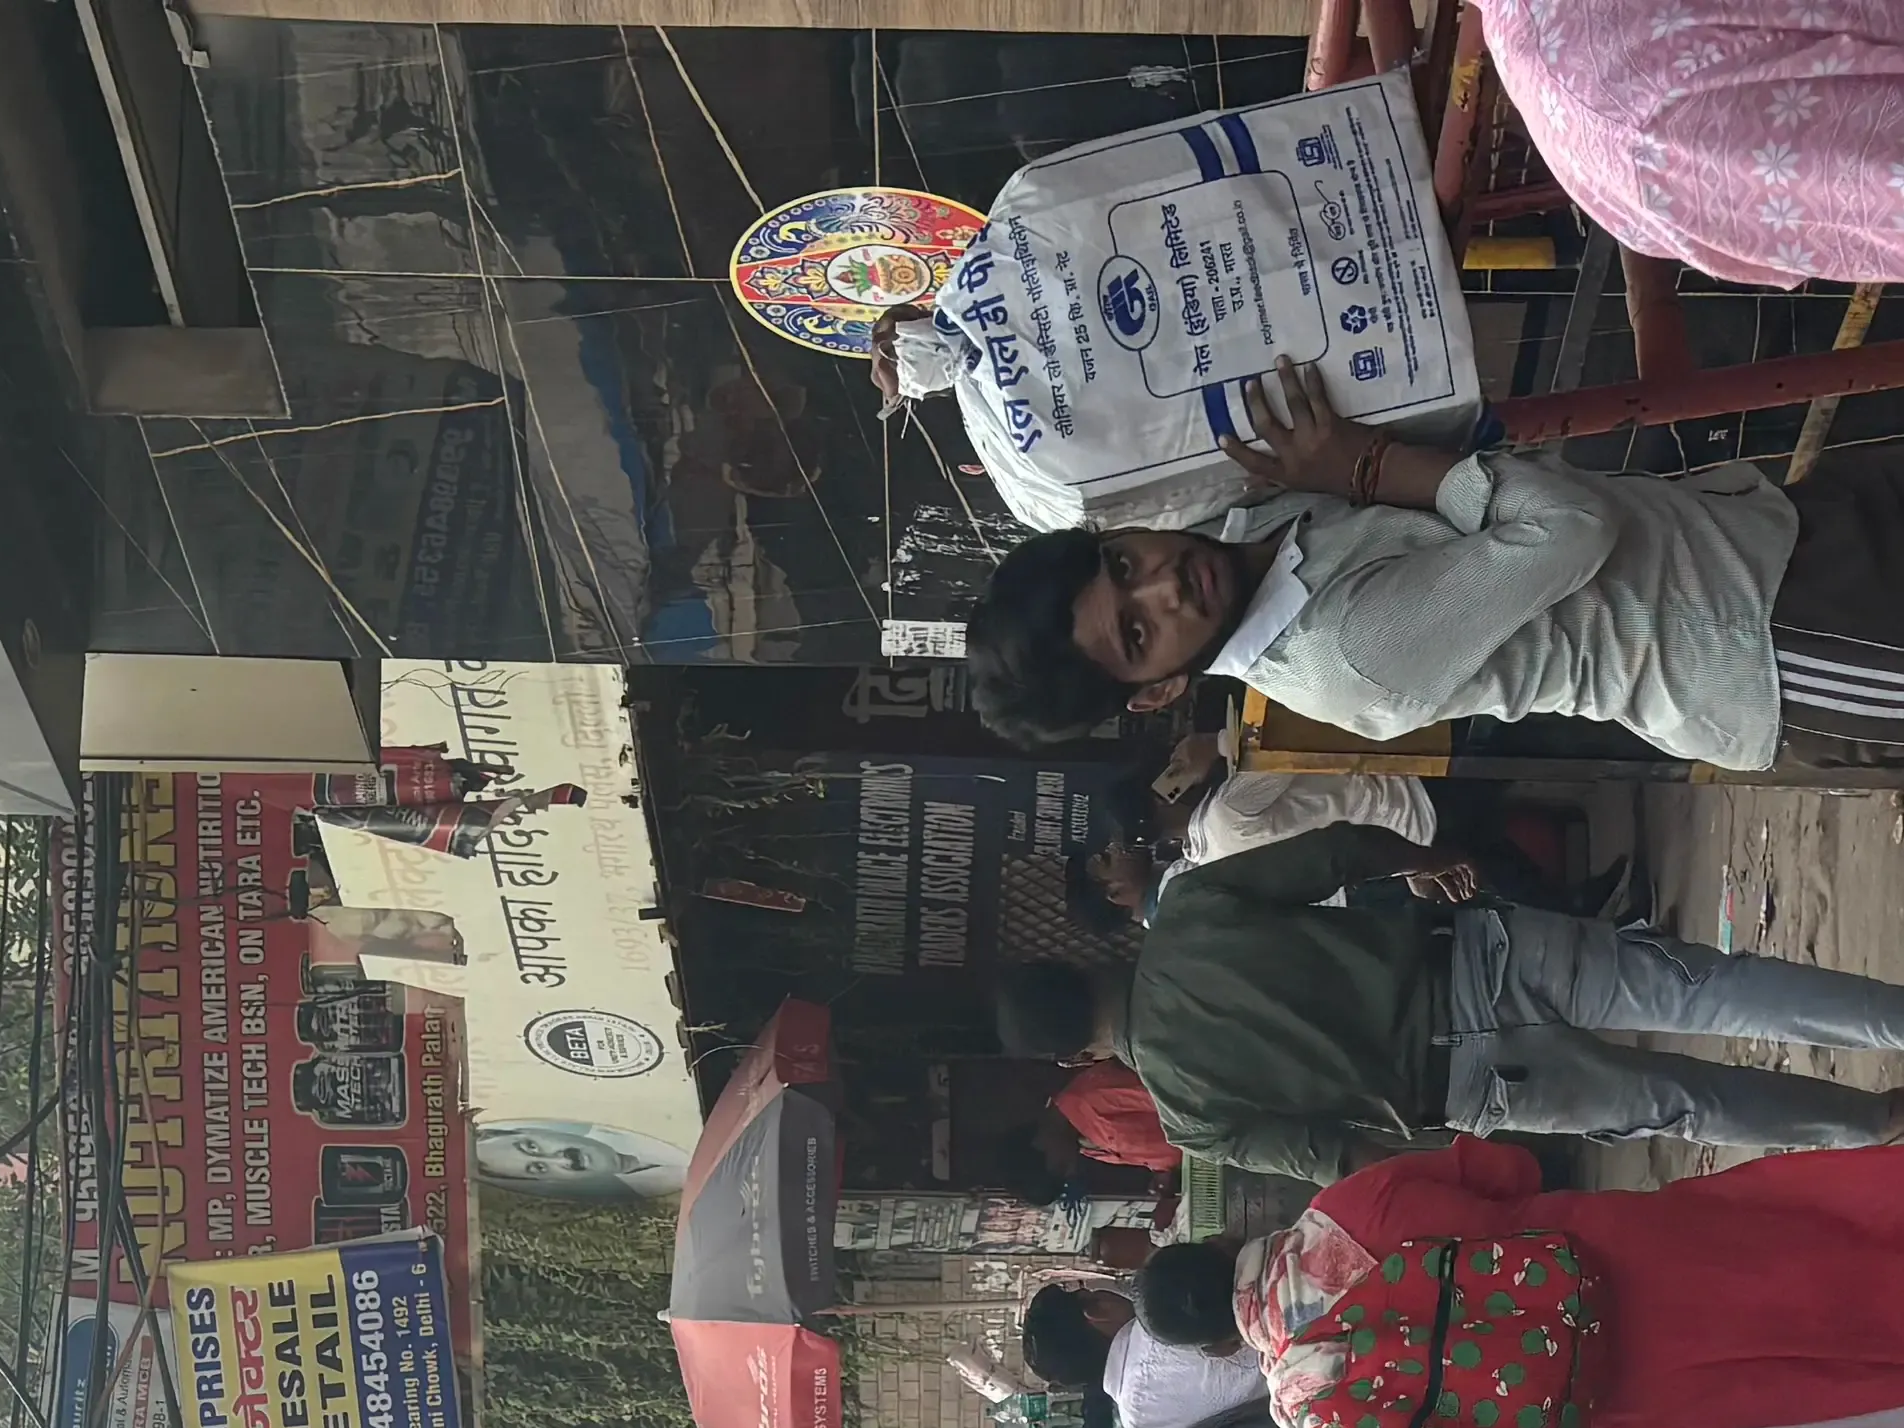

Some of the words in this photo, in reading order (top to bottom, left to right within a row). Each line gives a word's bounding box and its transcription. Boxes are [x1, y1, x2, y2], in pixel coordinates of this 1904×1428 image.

[1056, 251, 1069, 271] नेट
[1160, 203, 1191, 269] लिमिटेड
[1218, 241, 1237, 273] भारत
[1199, 240, 1221, 285] 206241
[961, 294, 1008, 331] डी
[1176, 274, 1209, 337] (इंडिया)
[1211, 296, 1227, 322] पाता
[1072, 324, 1089, 344] 25
[985, 334, 1029, 389] एल
[1044, 360, 1061, 380] लो
[1081, 347, 1097, 383] वजन
[1193, 344, 1212, 376] गेल
[1003, 399, 1042, 453] एल
[1050, 384, 1074, 439] लीनियर
[236, 790, 261, 845] ETC.
[858, 760, 914, 847] ELECTRONICS
[856, 851, 910, 896] PALACE
[920, 801, 976, 903] ASSOCIATION
[237, 854, 263, 920] TARA
[239, 930, 263, 964] ON
[500, 895, 567, 988] आपका
[918, 906, 969, 967] TRADERS
[199, 905, 227, 1043] AMERICAN
[240, 974, 268, 1034] BSN,
[565, 1027, 589, 1059] BETA
[241, 1043, 268, 1110] TECH
[203, 1052, 232, 1183] DYMATIZE
[423, 1075, 448, 1176] Bhagirath
[244, 1118, 272, 1225] MUSCLE
[805, 1137, 817, 1213] ACCESSORIES
[207, 1194, 236, 1241] MP,
[412, 1263, 427, 1274] 6
[392, 1296, 411, 1337] 1492
[414, 1292, 434, 1336] Delhi
[137, 1357, 151, 1400] MCB
[399, 1344, 415, 1372] No.
[423, 1342, 441, 1407] Chowk,
[114, 1407, 127, 1417] &
